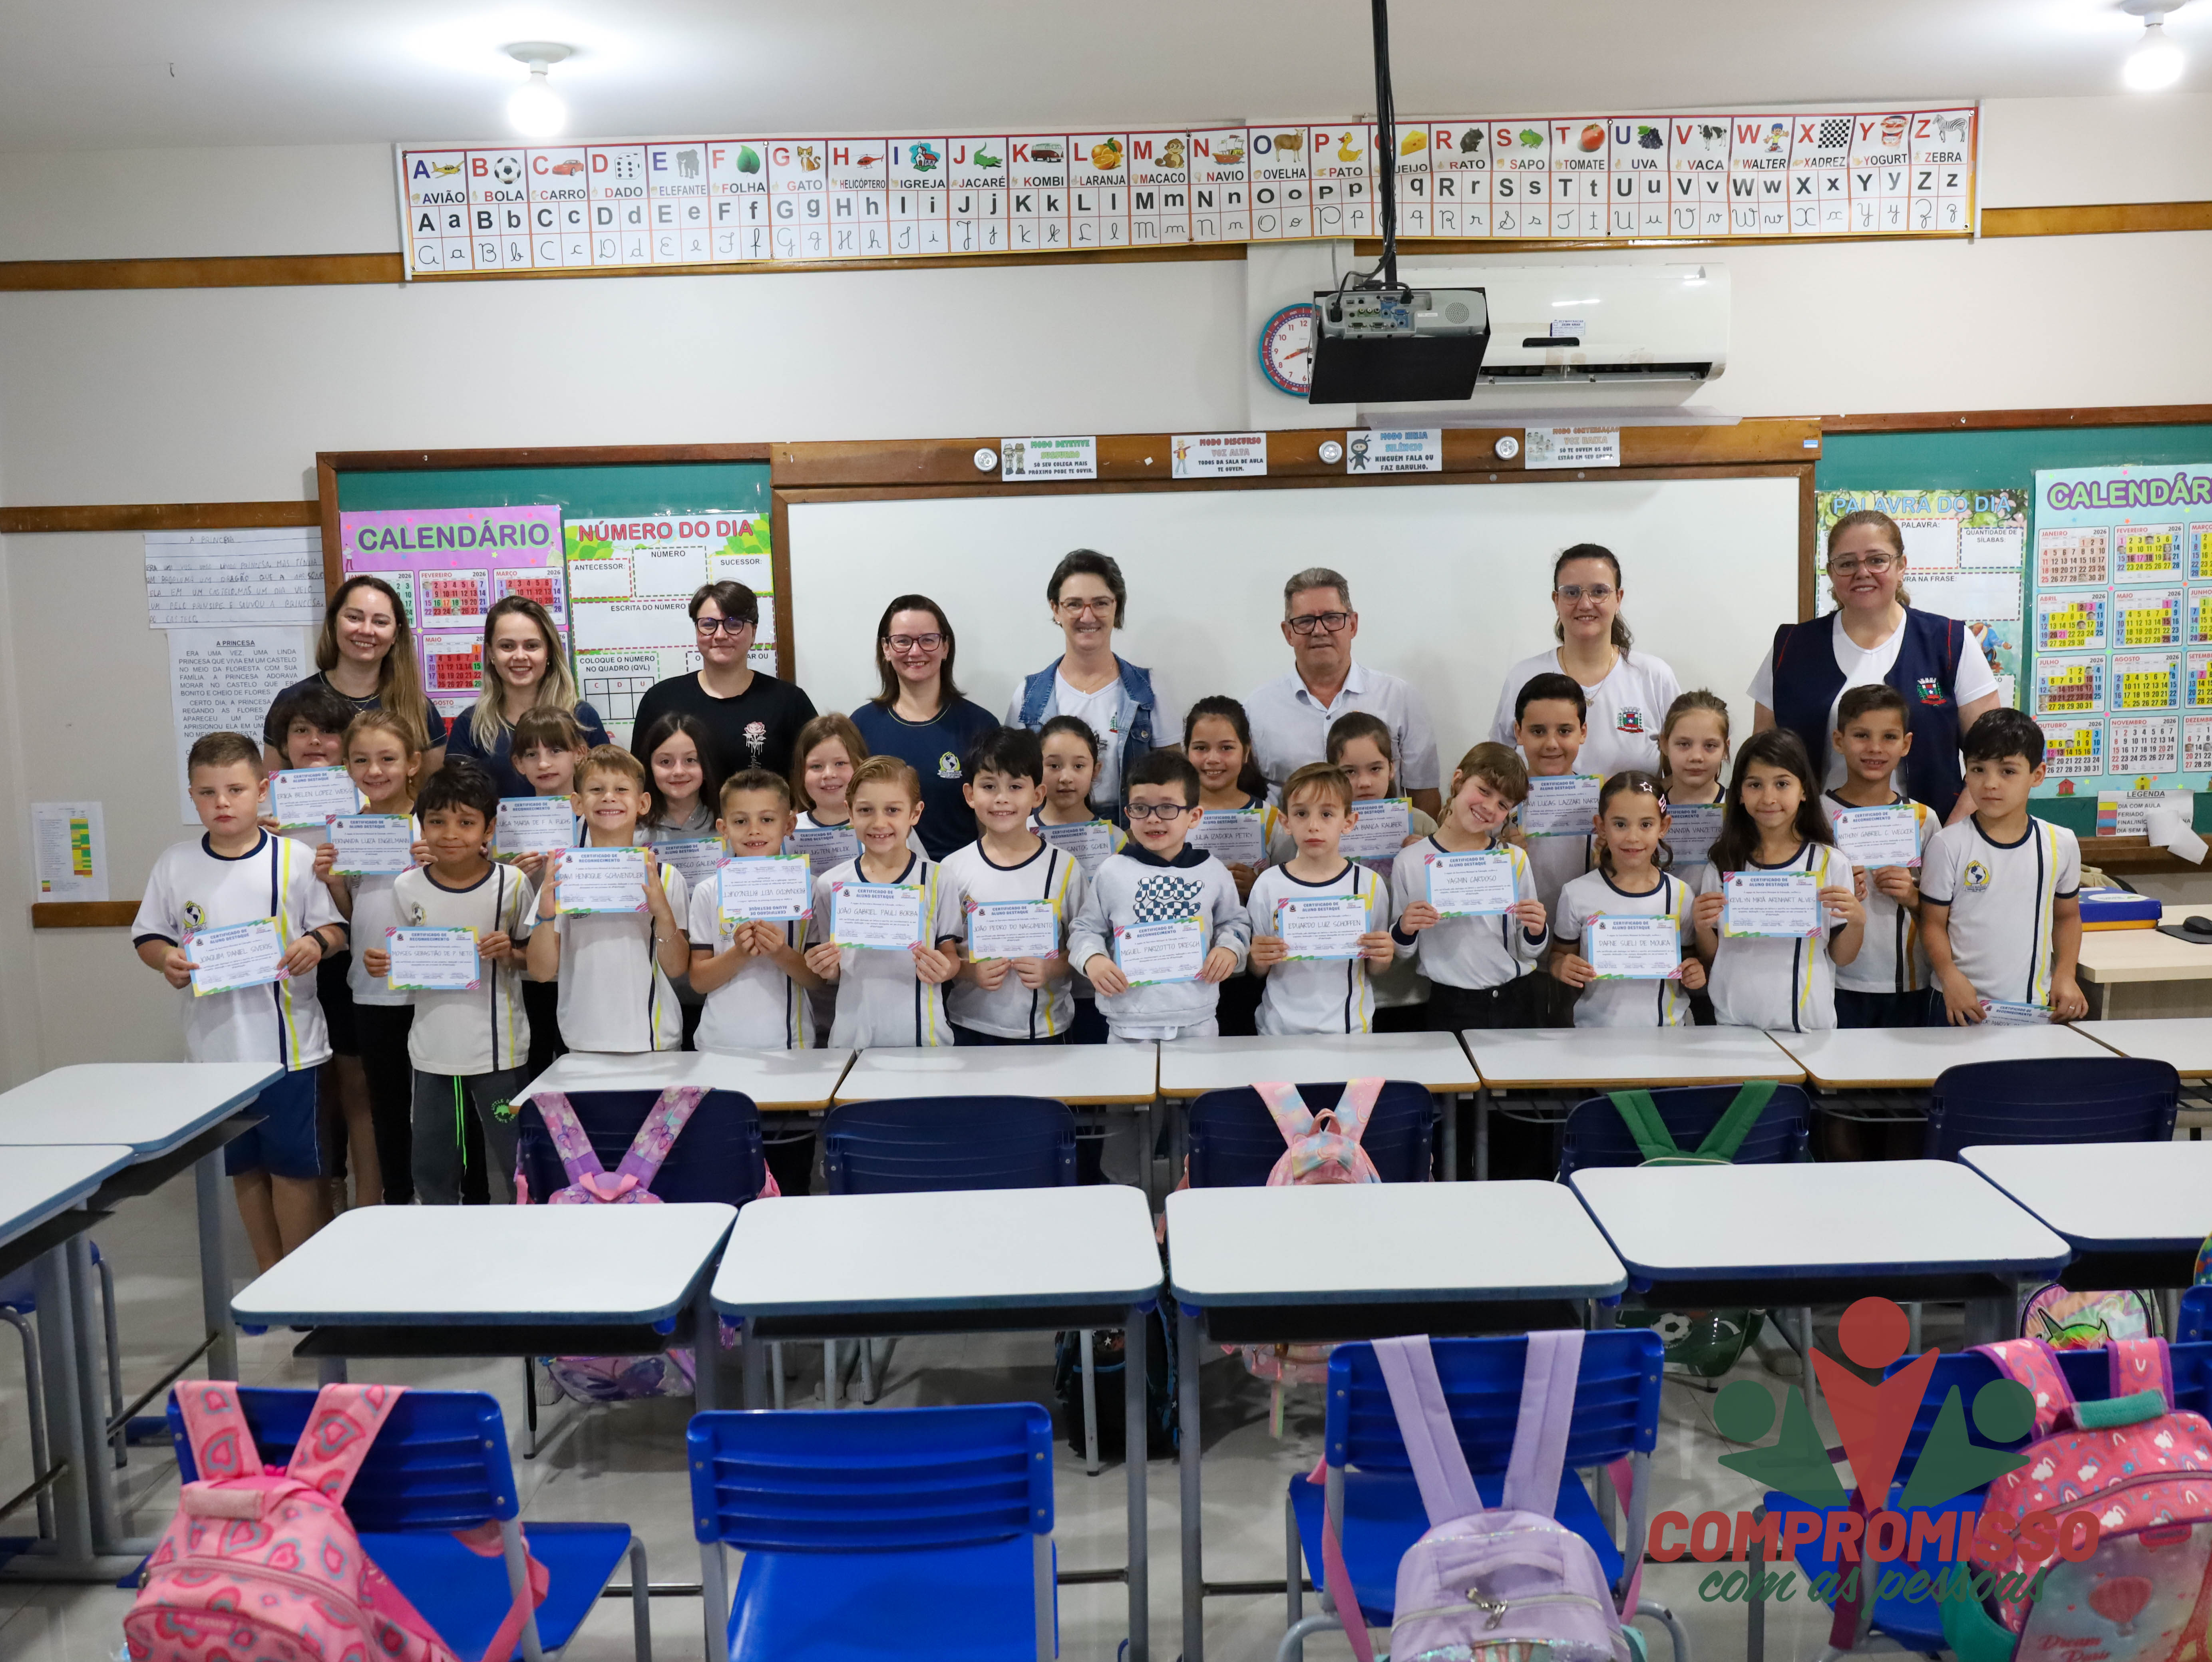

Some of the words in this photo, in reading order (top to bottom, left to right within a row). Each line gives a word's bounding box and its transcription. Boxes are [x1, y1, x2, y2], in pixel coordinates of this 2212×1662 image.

[1804, 157, 1845, 168] XADREZ
[1864, 154, 1907, 165] YOGURT
[1925, 152, 1961, 162] ZEBRA
[1450, 160, 1485, 170] RATO
[1510, 159, 1545, 170] SAPO
[1564, 159, 1604, 170] TOMATE
[1632, 159, 1657, 169] UVA
[1688, 159, 1724, 169] VACA
[1743, 159, 1786, 169] WALTER
[1207, 171, 1244, 182] NAVIO
[1263, 168, 1306, 179] OVELHA
[1329, 167, 1363, 177] PATO
[840, 178, 885, 189] HELICÓPTERO
[900, 179, 945, 189] IGREJA
[959, 176, 1005, 187] JACARÉ
[1024, 176, 1064, 187] KOMBI
[1080, 175, 1126, 186] LARANJA
[1140, 173, 1186, 184] MACACO
[659, 185, 706, 196] ELEFANTE
[722, 181, 766, 193] FOLHA
[787, 180, 823, 191] GATO
[423, 191, 465, 204] AVIÃO
[485, 191, 524, 201] BOLA
[540, 189, 586, 200] CARRO
[605, 187, 643, 198] DADO
[1224, 437, 1261, 445] DISCURSO
[1385, 442, 1422, 452] SILÊNCIO
[1938, 497, 1967, 513] DO
[1975, 496, 2011, 512] DIA
[358, 520, 549, 550] CALENDÁRIO
[579, 520, 672, 541] NÚMERO
[679, 521, 710, 538] DO
[716, 519, 753, 537] DIA
